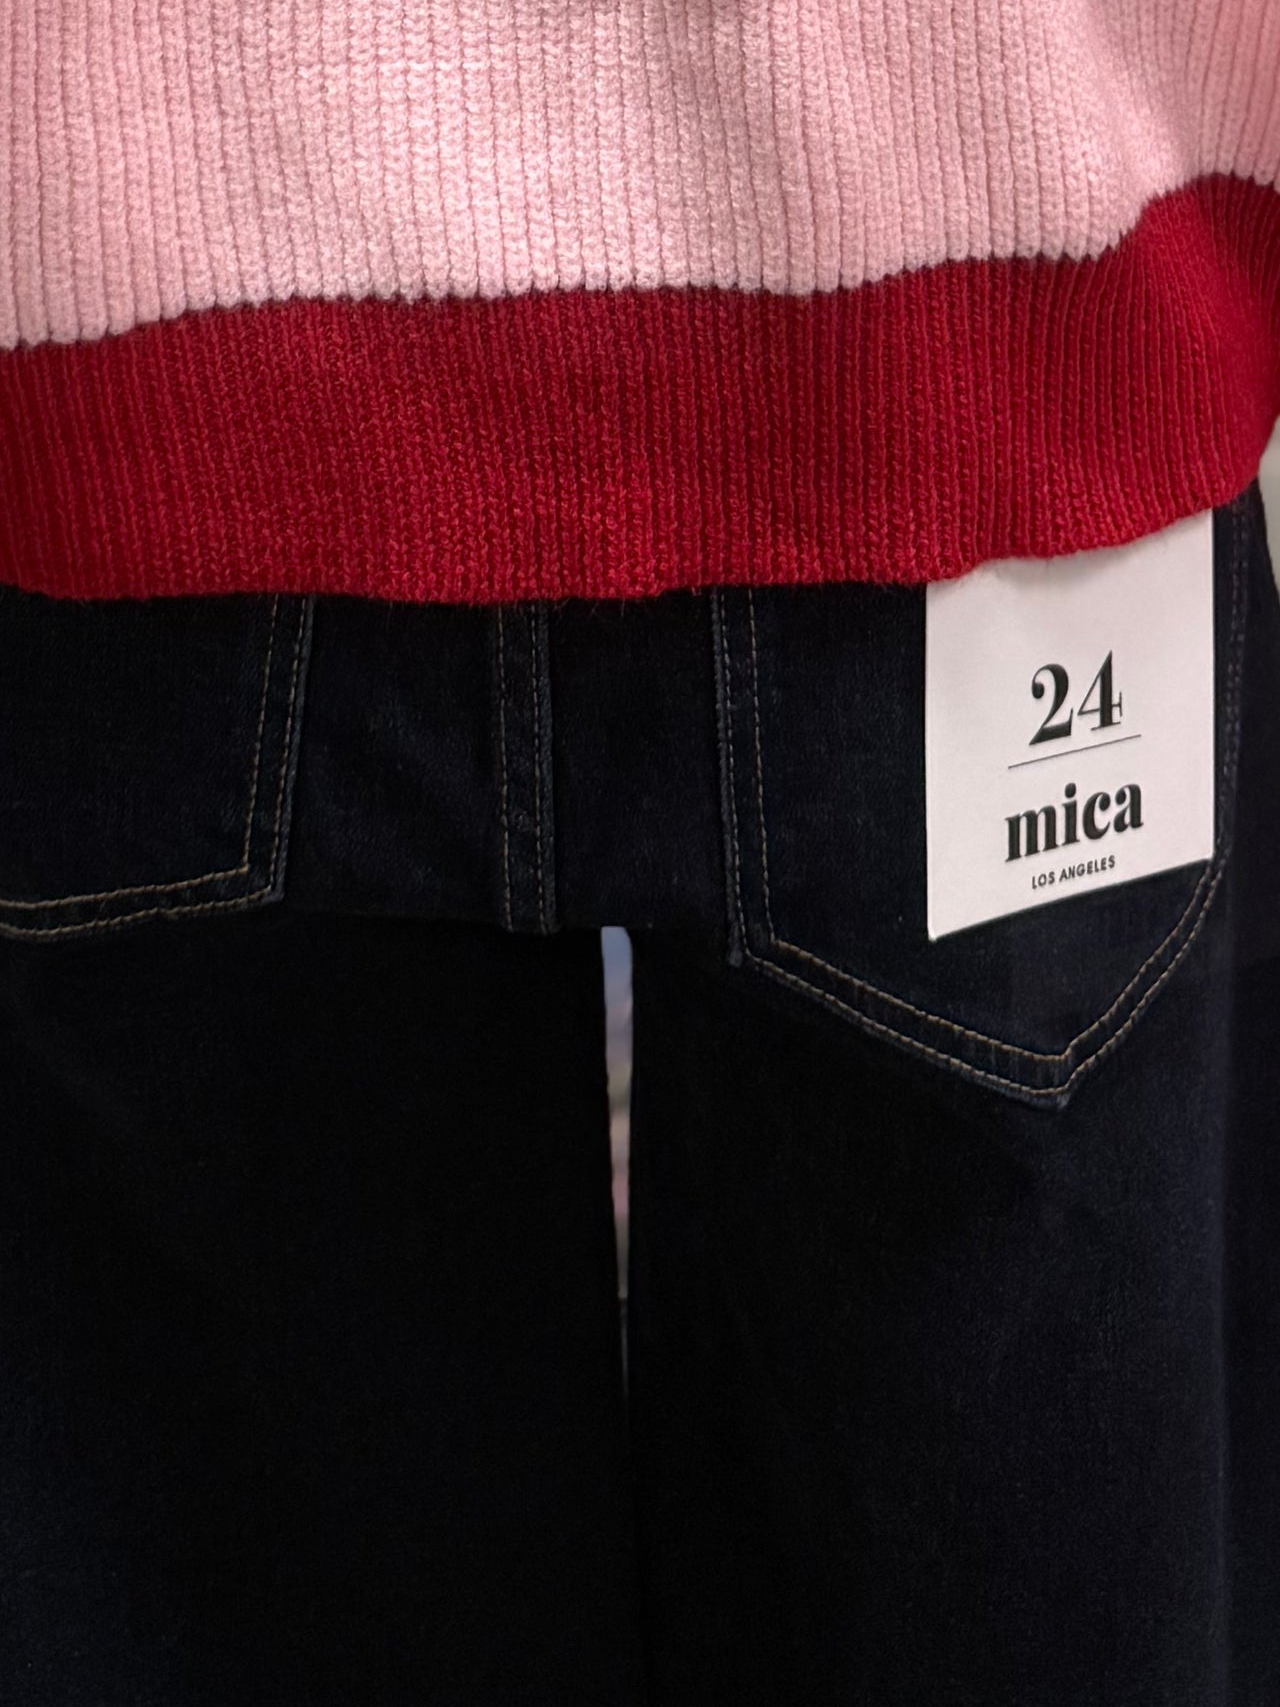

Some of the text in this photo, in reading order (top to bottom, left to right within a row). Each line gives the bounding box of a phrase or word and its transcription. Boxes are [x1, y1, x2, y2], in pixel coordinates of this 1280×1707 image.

[1028, 650, 1124, 747] 24
[1004, 782, 1145, 863] mica
[1031, 855, 1117, 890] LOS ANGELES
